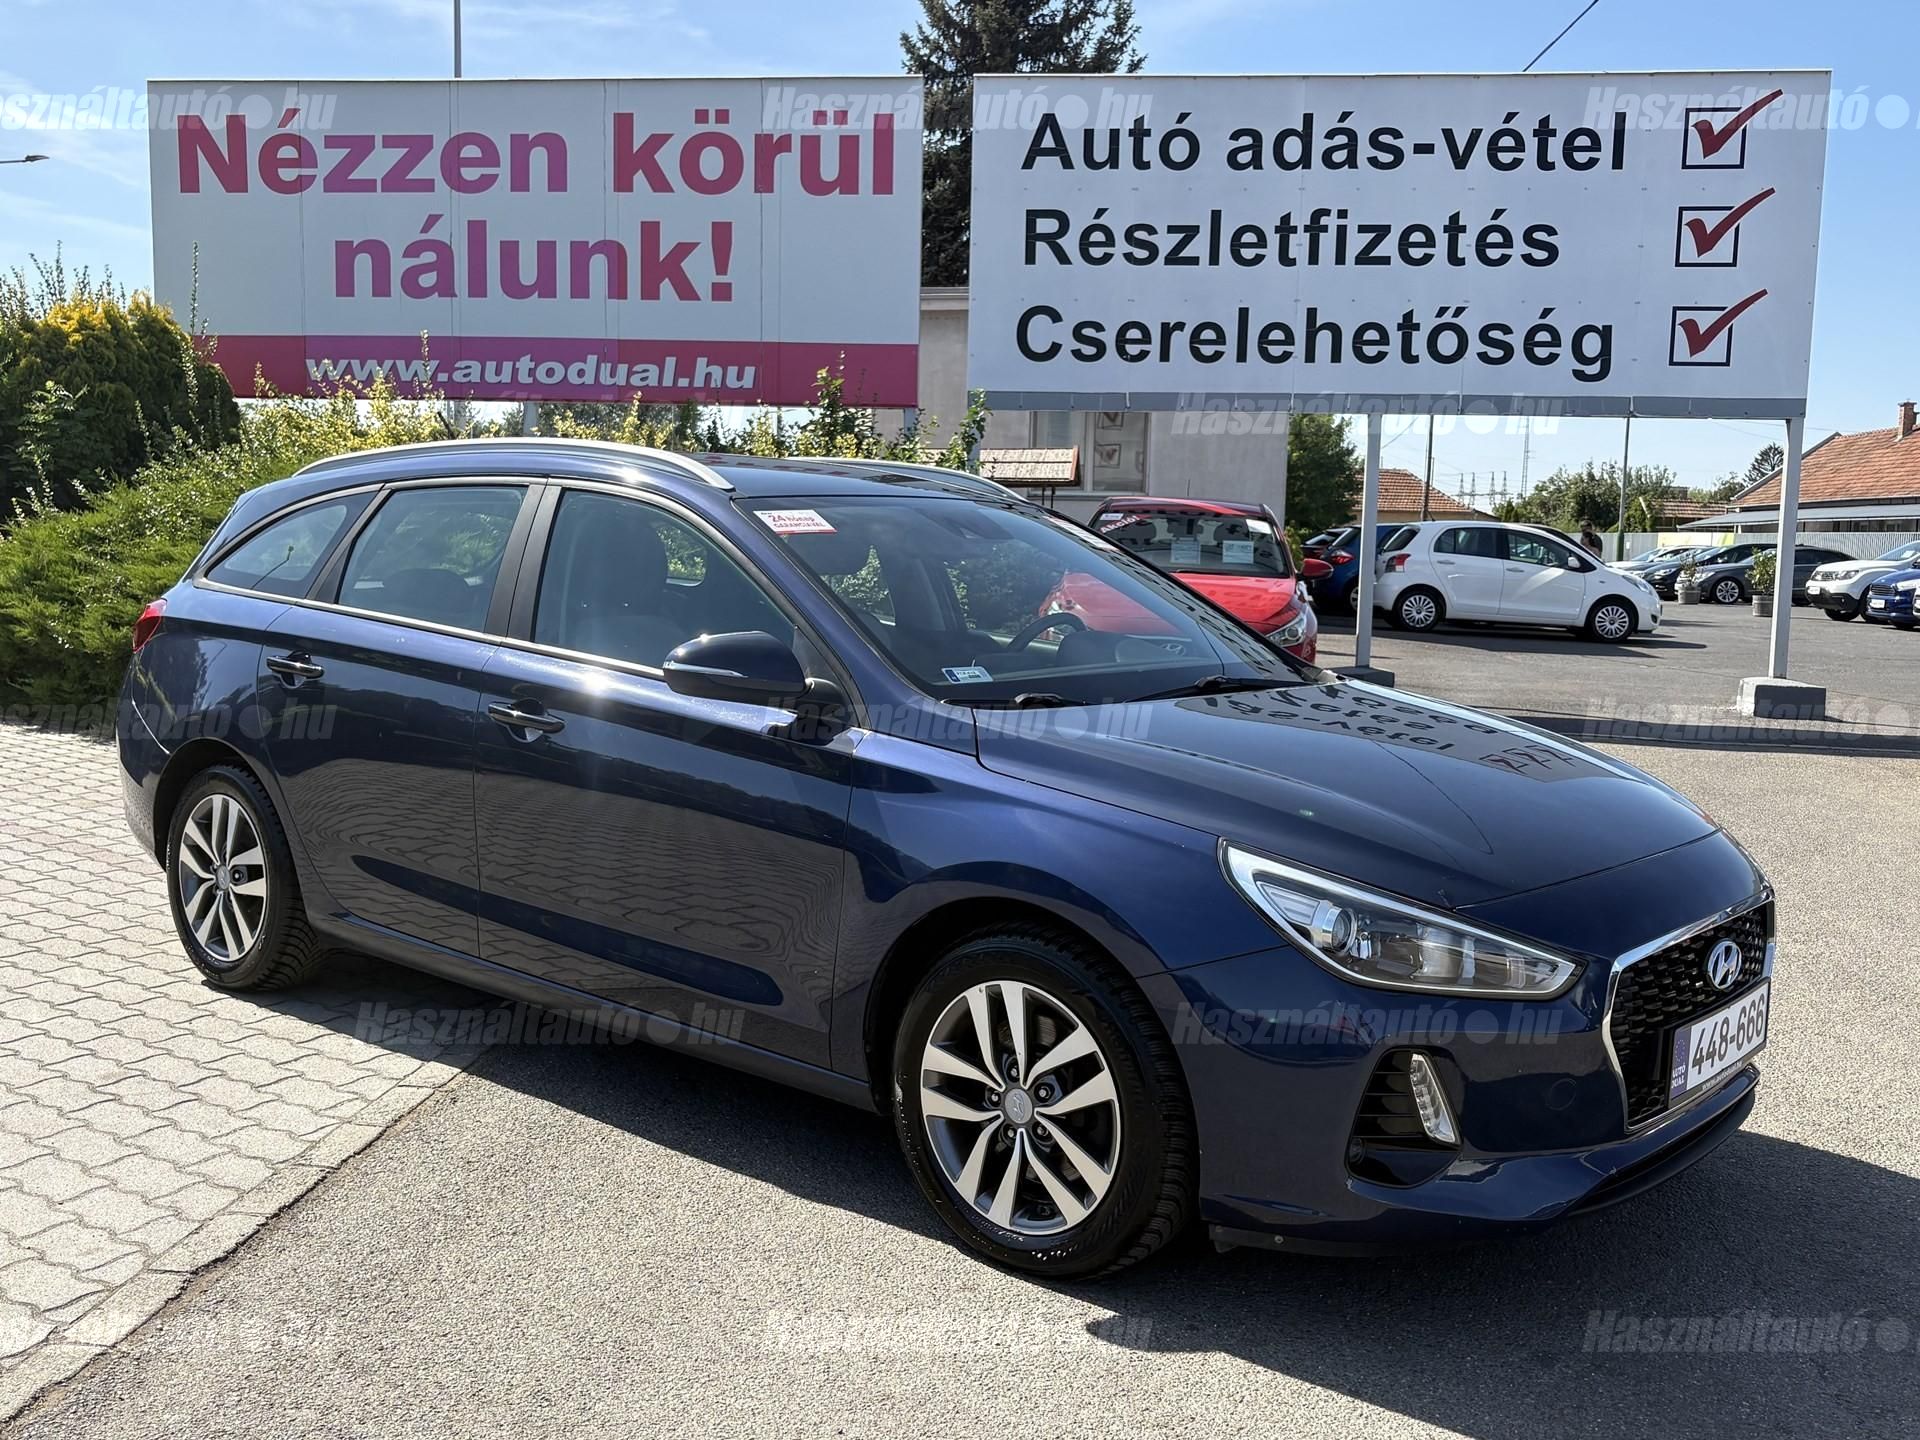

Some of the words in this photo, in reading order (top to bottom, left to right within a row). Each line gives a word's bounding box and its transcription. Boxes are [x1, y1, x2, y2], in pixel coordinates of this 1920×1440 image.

[177, 107, 568, 195] Nézzen
[613, 108, 894, 196] körül
[1021, 111, 1201, 171] Autó
[1226, 110, 1626, 171] adás-vétel
[335, 213, 733, 302] nálunk!
[1025, 207, 1559, 268] Részletfizetés
[306, 354, 756, 389] www.autodual.hu
[1016, 304, 1614, 382] Cserelehetőség
[1691, 993, 1765, 1075] 448-666
